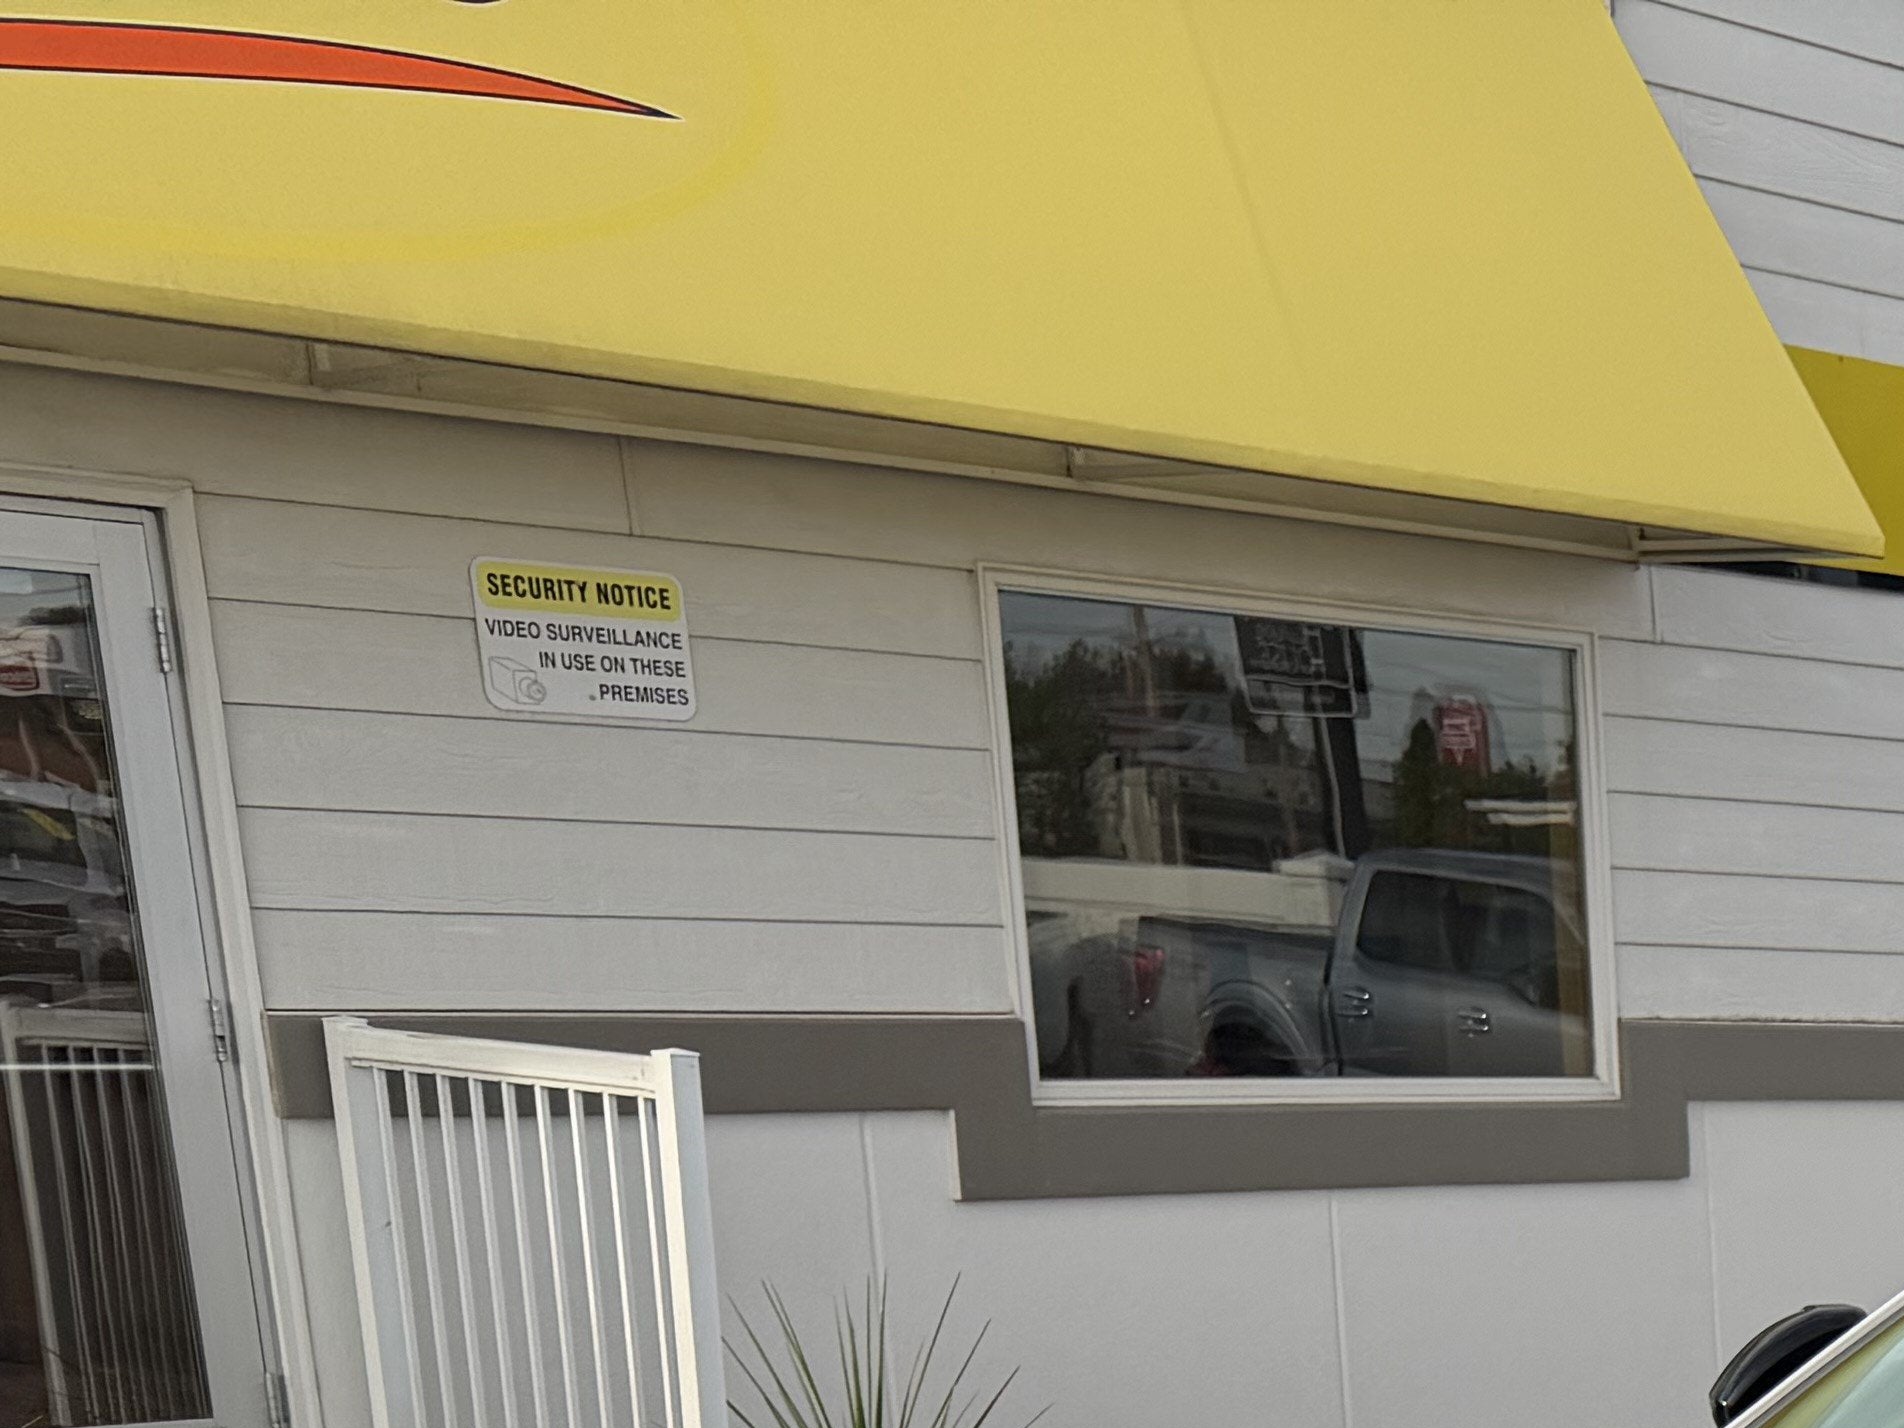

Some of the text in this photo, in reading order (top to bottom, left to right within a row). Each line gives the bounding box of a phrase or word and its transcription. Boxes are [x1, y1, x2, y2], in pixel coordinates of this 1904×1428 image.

[487, 572, 671, 610] SECURITY NOTICE
[485, 618, 683, 650] VIDEO SURVEILLANCE
[539, 651, 686, 678] IN USE ON THESE
[599, 683, 689, 706] PREMISES
